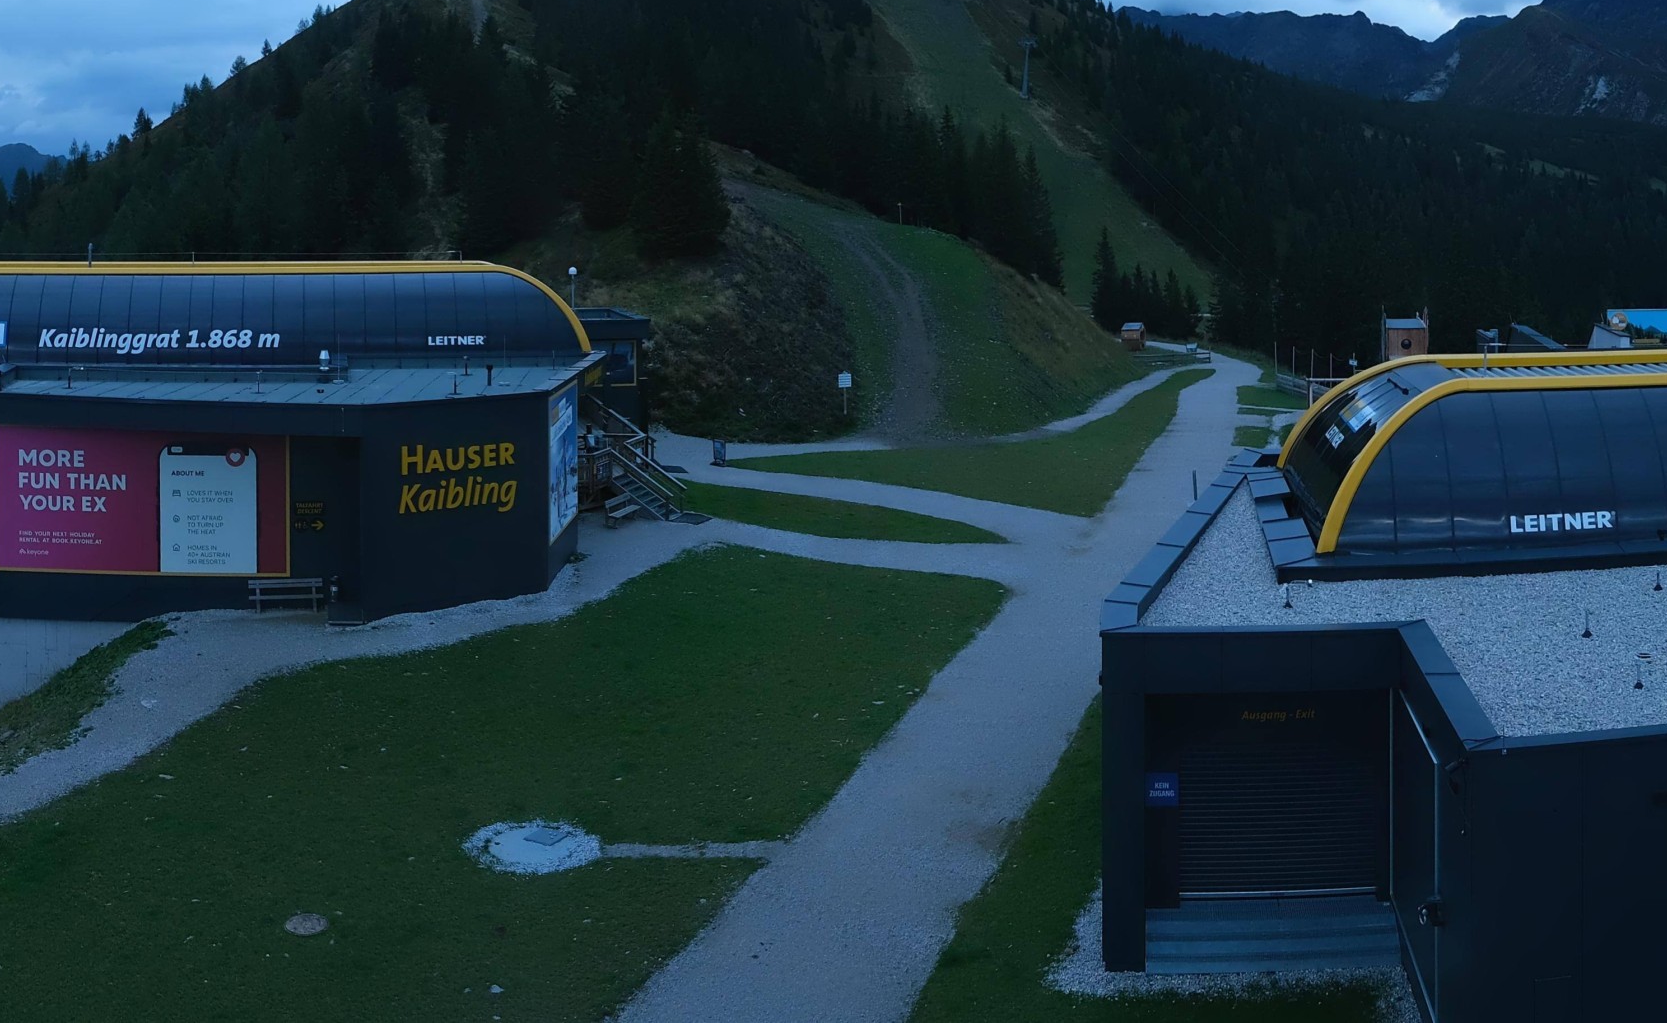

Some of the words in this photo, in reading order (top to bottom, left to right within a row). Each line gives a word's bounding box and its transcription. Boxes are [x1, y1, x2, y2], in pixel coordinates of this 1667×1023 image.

[38, 327, 179, 354] Kaiblinggrat
[184, 329, 252, 348] 1.868
[258, 333, 280, 348] m
[427, 335, 485, 346] LEITNER
[18, 449, 85, 467] MORE
[400, 442, 516, 476] HAUSER
[18, 472, 60, 489] FUN
[66, 473, 127, 490] THAN
[20, 495, 75, 512] YOUR
[82, 496, 107, 513] EX
[399, 475, 518, 515] Kaibling
[1509, 510, 1613, 533] LEITNER
[1241, 710, 1287, 722] Ausgang
[1295, 708, 1316, 719] Exit
[1154, 782, 1170, 790] KEIN
